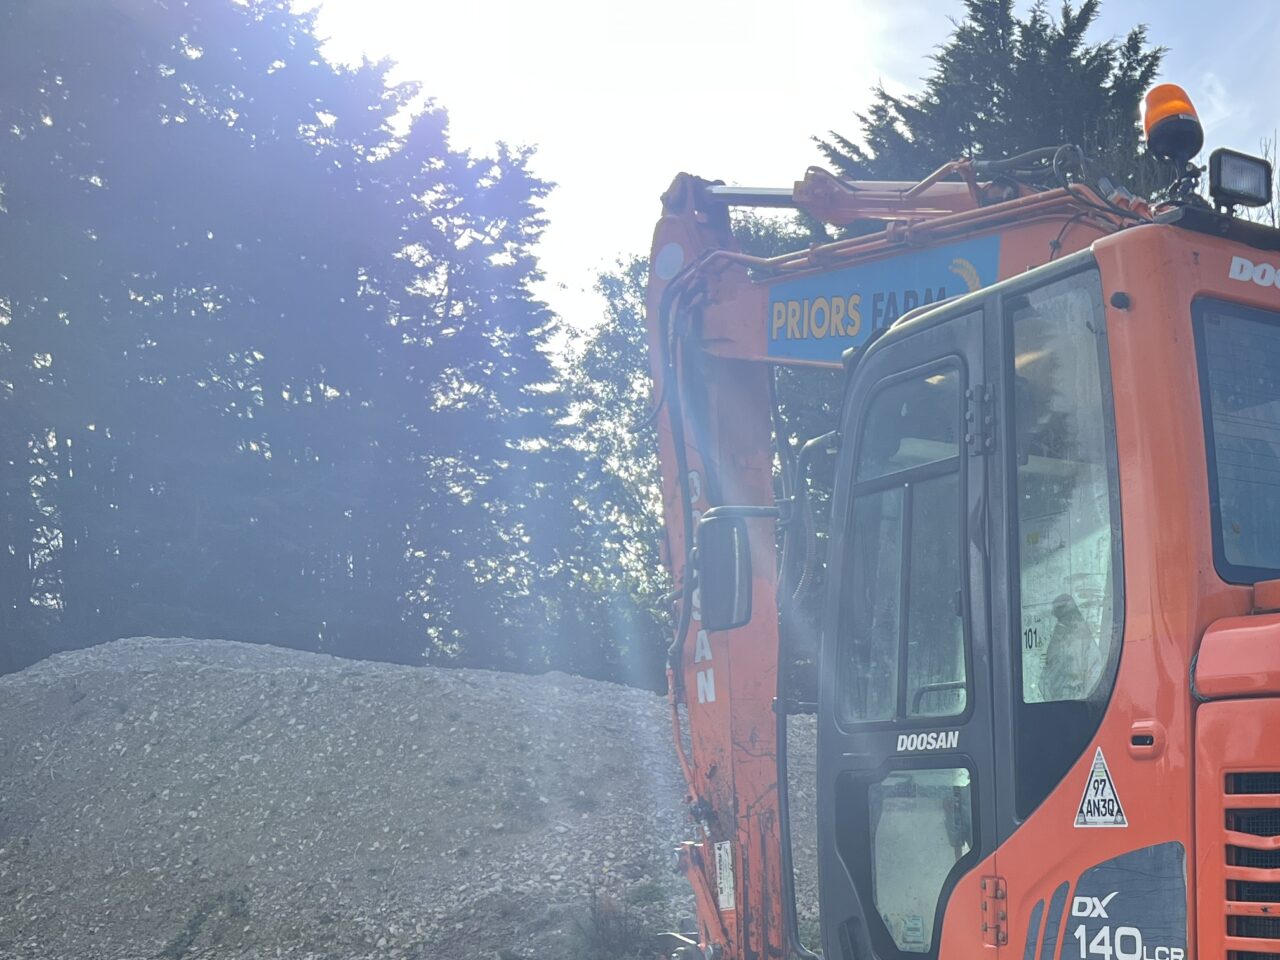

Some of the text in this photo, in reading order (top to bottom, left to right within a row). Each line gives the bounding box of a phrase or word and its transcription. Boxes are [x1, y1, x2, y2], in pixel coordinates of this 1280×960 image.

[771, 293, 862, 340] PRIORS
[1024, 628, 1038, 649] 101
[896, 731, 959, 752] DOOSAN
[1092, 779, 1106, 797] 97
[1086, 799, 1115, 817] AN3Q
[1071, 891, 1119, 919] DX
